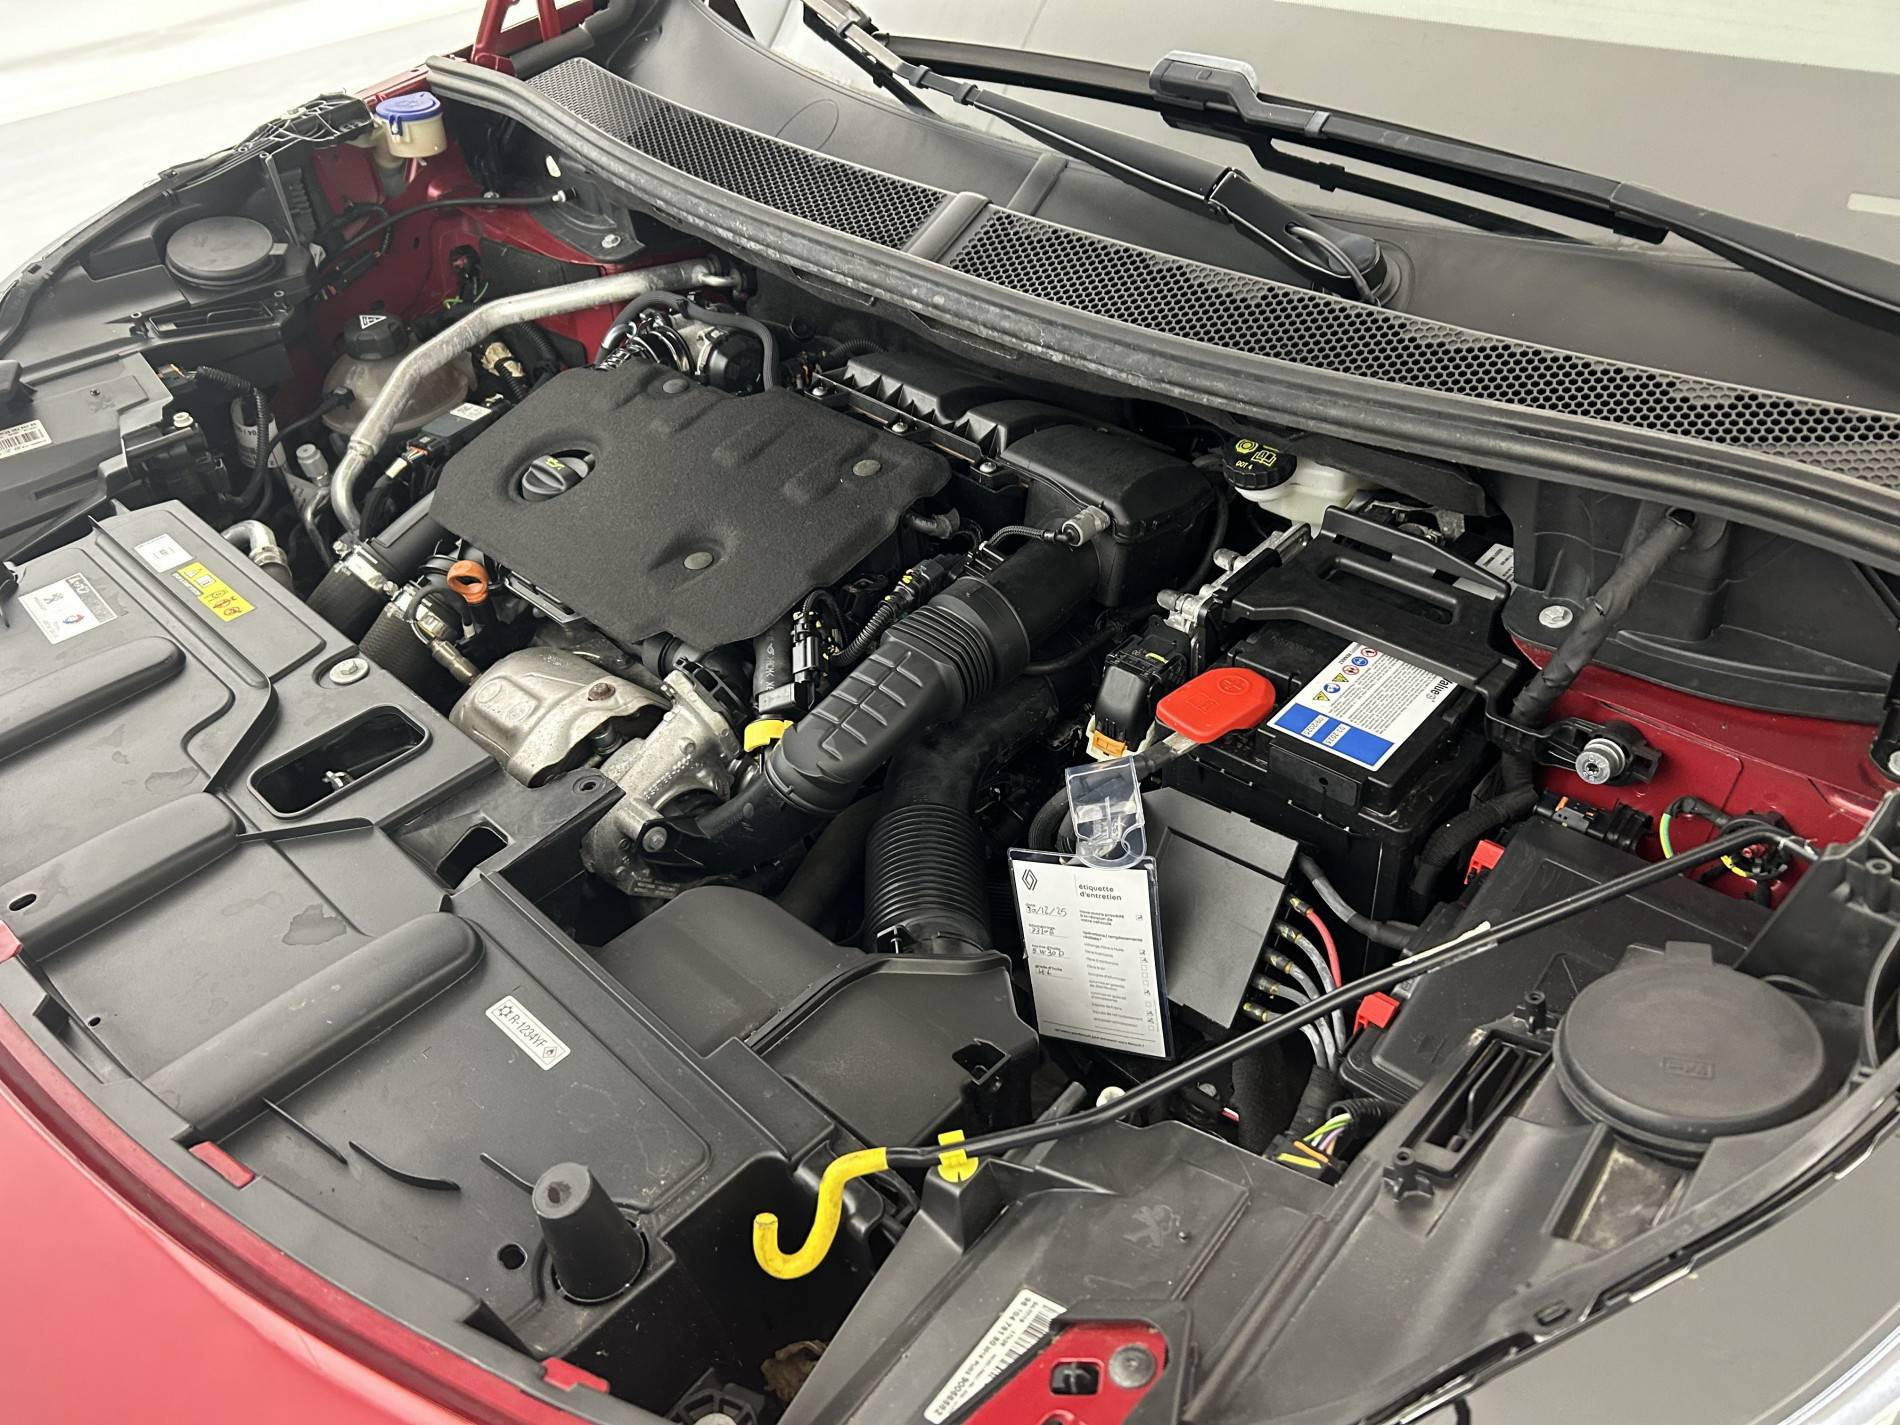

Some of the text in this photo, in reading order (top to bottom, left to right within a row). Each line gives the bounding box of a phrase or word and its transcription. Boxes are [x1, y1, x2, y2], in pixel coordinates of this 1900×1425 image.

[1235, 460, 1248, 469] DOT
[1079, 884, 1114, 892] étiquette
[1080, 891, 1122, 901] d'entretien
[508, 1015, 548, 1048] R-1234YF
